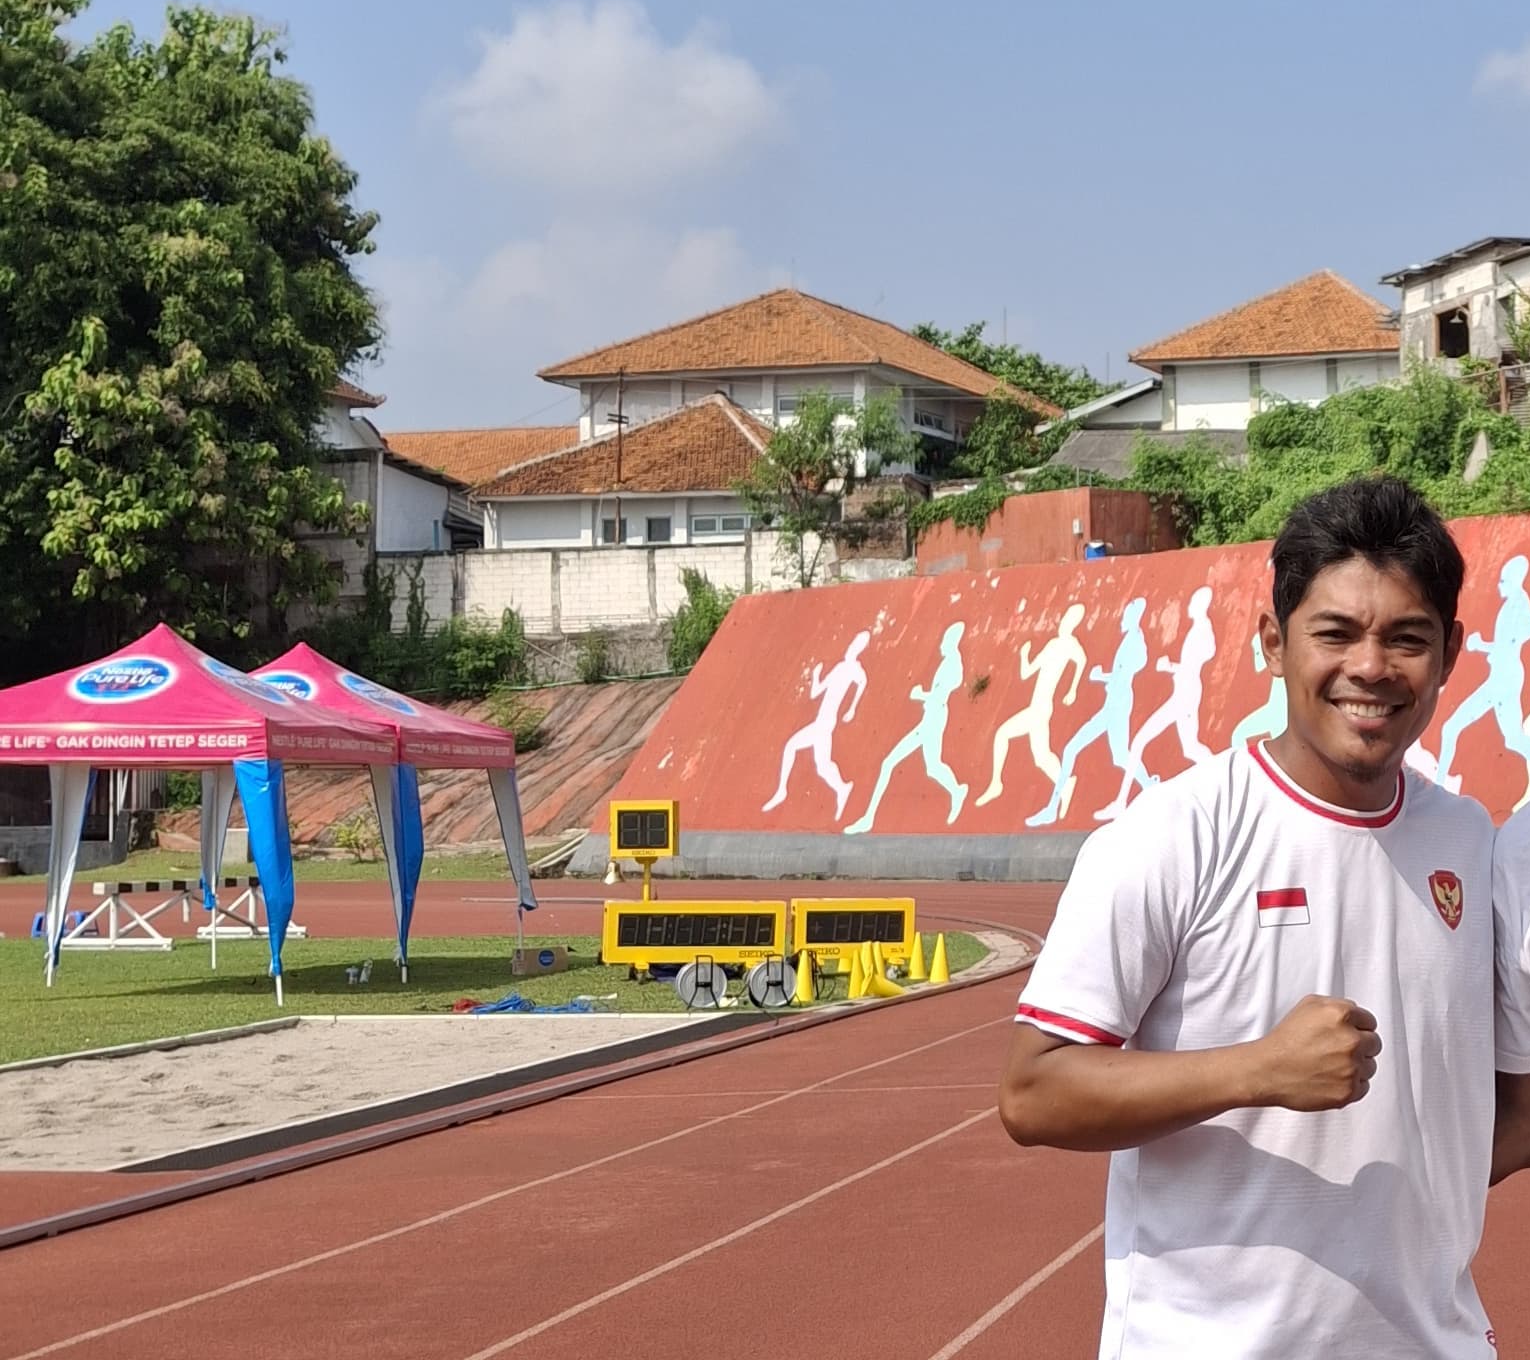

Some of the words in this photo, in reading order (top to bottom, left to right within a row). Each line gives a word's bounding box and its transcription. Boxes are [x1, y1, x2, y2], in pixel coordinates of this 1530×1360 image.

[81, 672, 128, 684] Pure
[131, 673, 165, 687] Life
[56, 735, 89, 748] GAK
[92, 735, 145, 748] DINGIN
[149, 735, 195, 748] TETEP
[198, 734, 247, 747] SEGER
